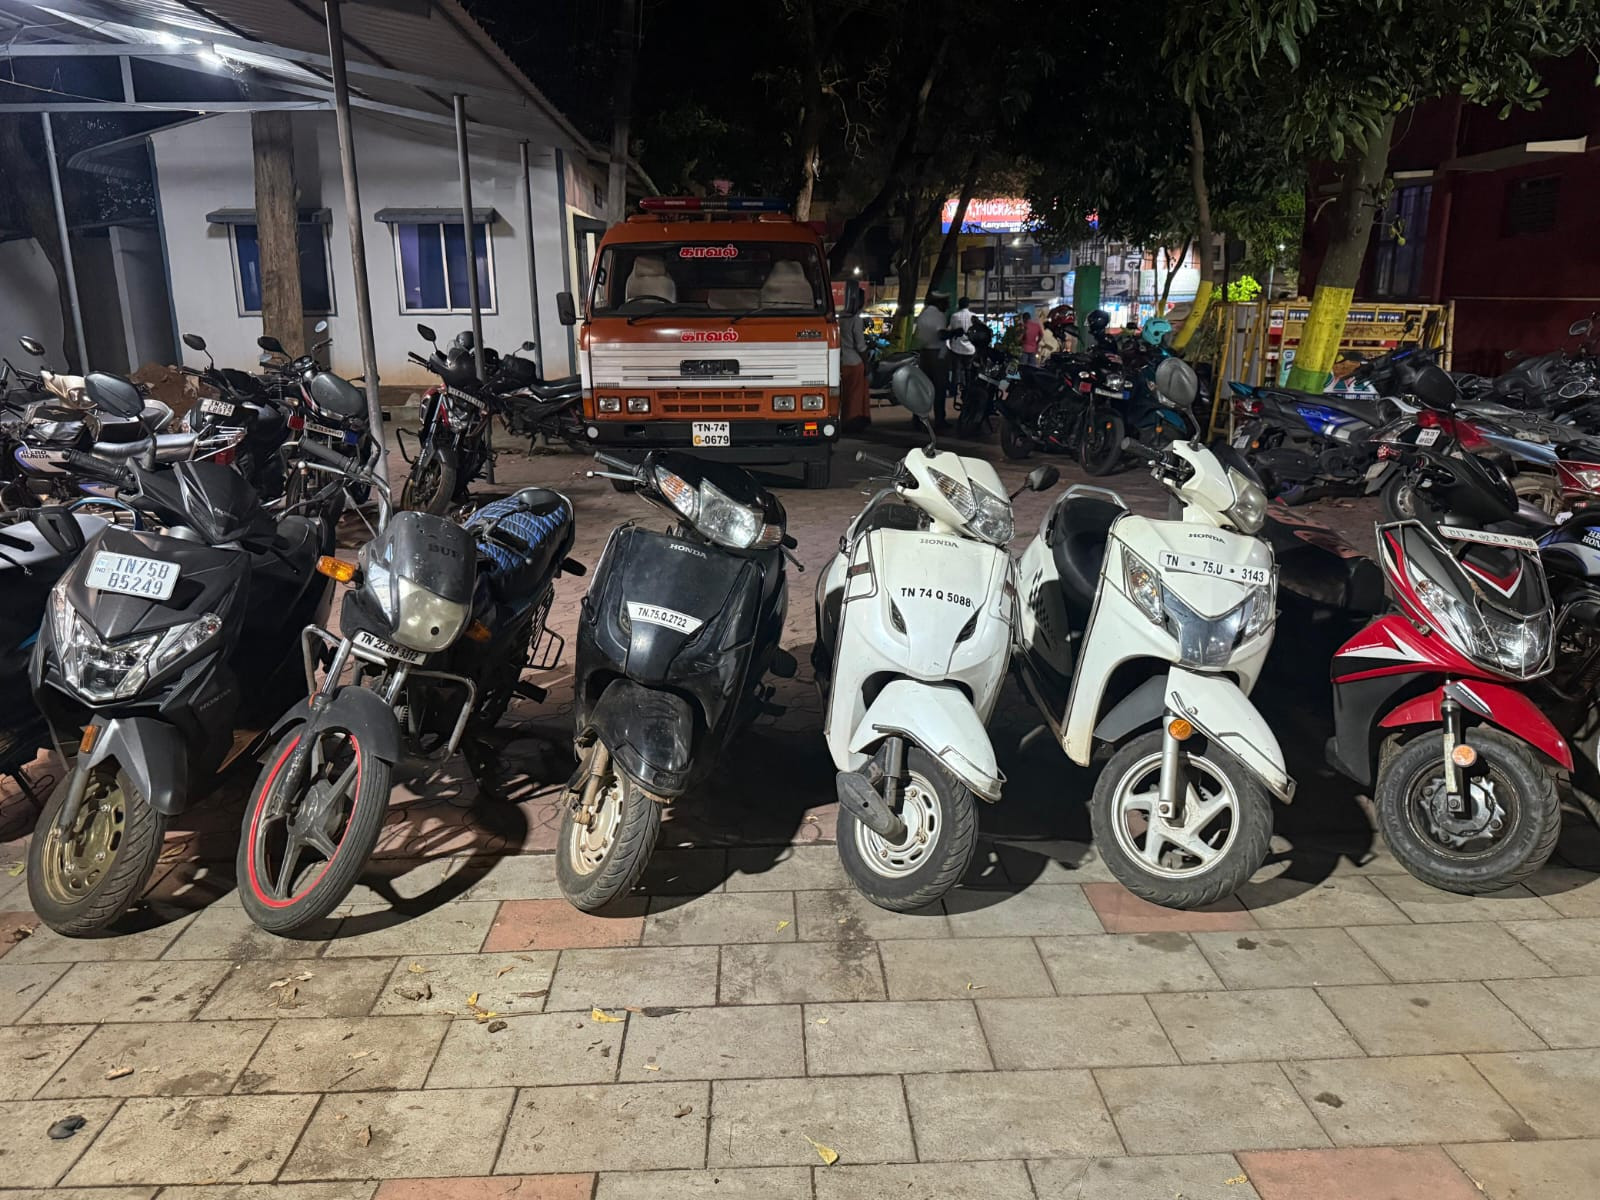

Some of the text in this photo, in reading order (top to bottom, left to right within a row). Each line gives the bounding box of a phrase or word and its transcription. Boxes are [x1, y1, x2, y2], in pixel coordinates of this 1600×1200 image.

[680, 244, 738, 258] காவல்
[681, 328, 739, 343] காவல்
[693, 435, 729, 445] G-0679
[919, 538, 959, 548] HONDA
[1188, 533, 1226, 544] HONDA
[669, 543, 708, 559] HONDA
[1166, 554, 1179, 566] TN
[1241, 568, 1264, 583] 3143
[901, 587, 971, 607] TN 74 Q 5088
[360, 633, 375, 645] TN
